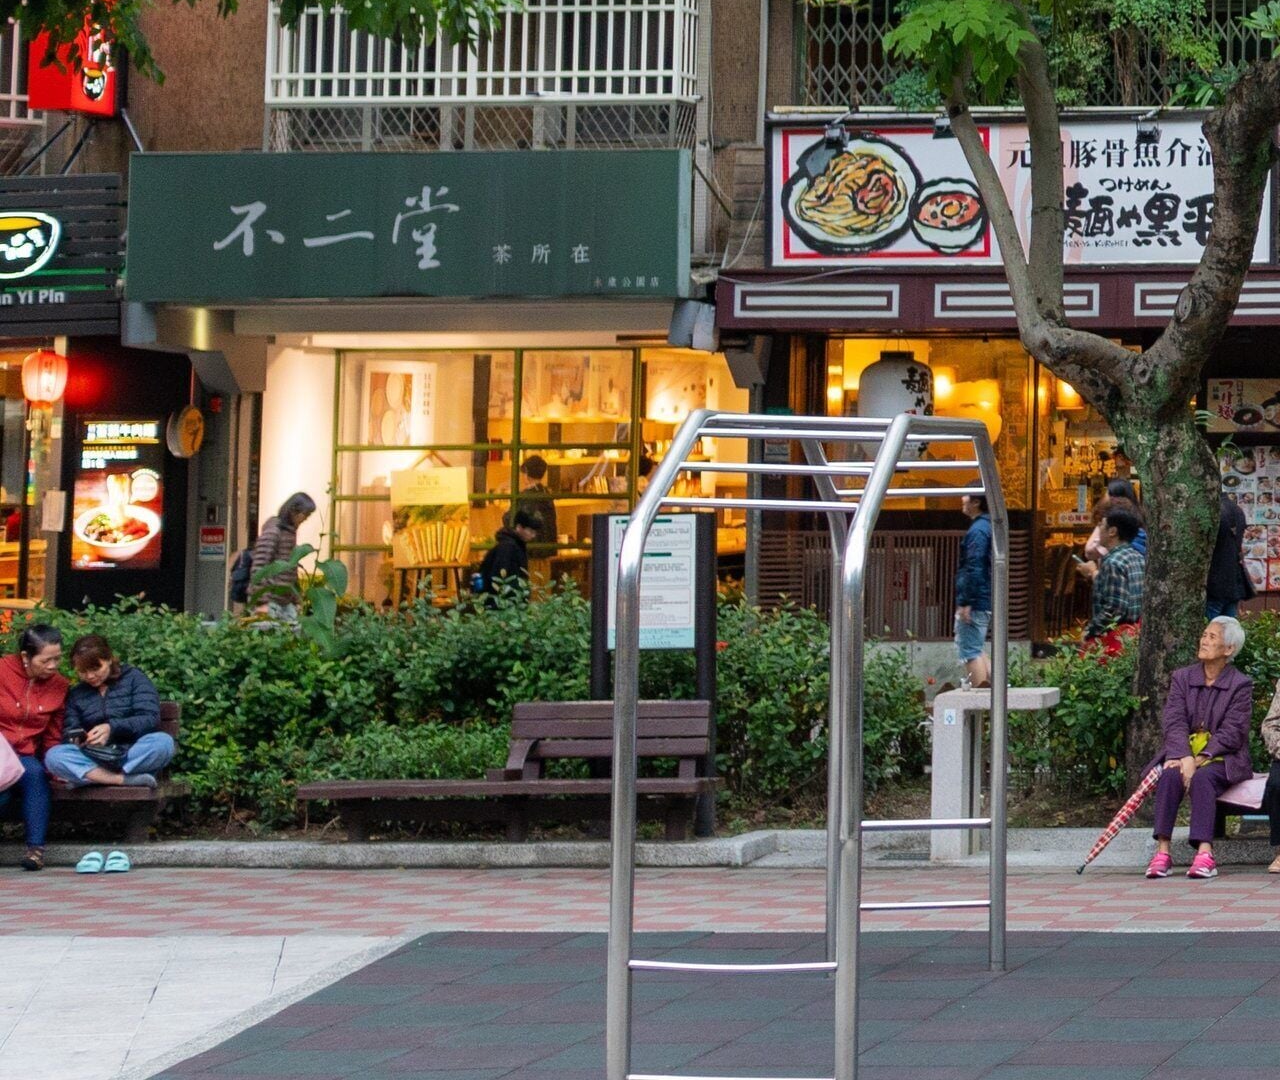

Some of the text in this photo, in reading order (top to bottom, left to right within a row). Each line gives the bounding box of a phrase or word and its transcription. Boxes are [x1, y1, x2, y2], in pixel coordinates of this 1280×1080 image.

[1006, 137, 1213, 169] 元豚骨魚介
[1099, 175, 1172, 193] つけめん
[212, 184, 461, 270] 不二堂
[491, 242, 591, 265] 茶所在
